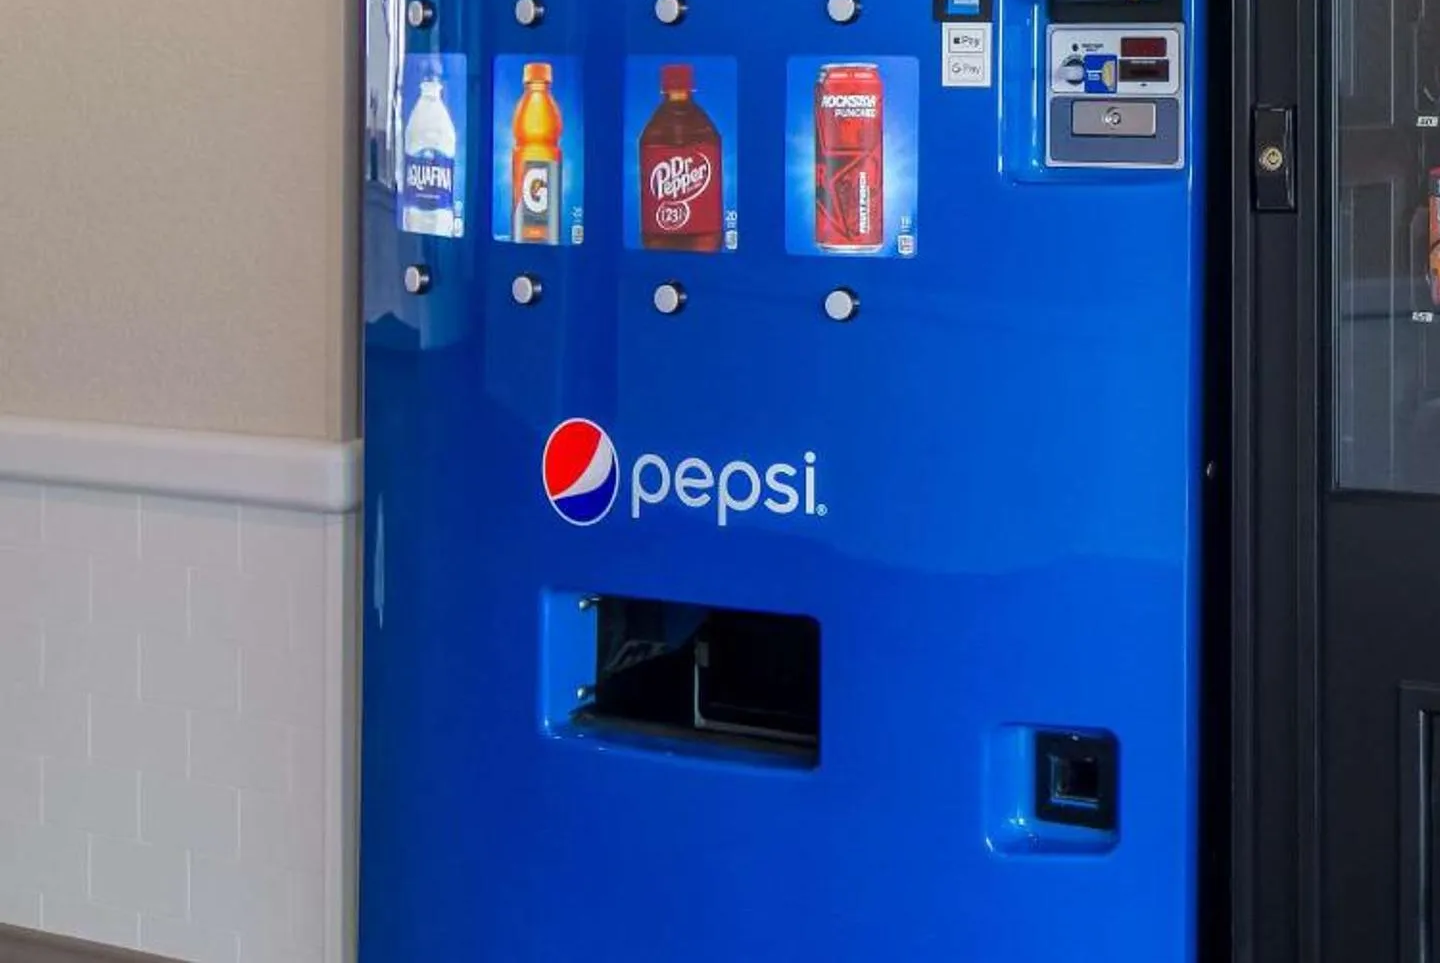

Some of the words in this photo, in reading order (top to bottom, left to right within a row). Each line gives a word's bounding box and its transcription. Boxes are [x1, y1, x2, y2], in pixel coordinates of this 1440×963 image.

[961, 36, 980, 47] Pay
[657, 161, 707, 199] Pepper
[671, 156, 693, 177] Dr
[523, 168, 548, 213] G
[631, 450, 816, 526] pepsi
